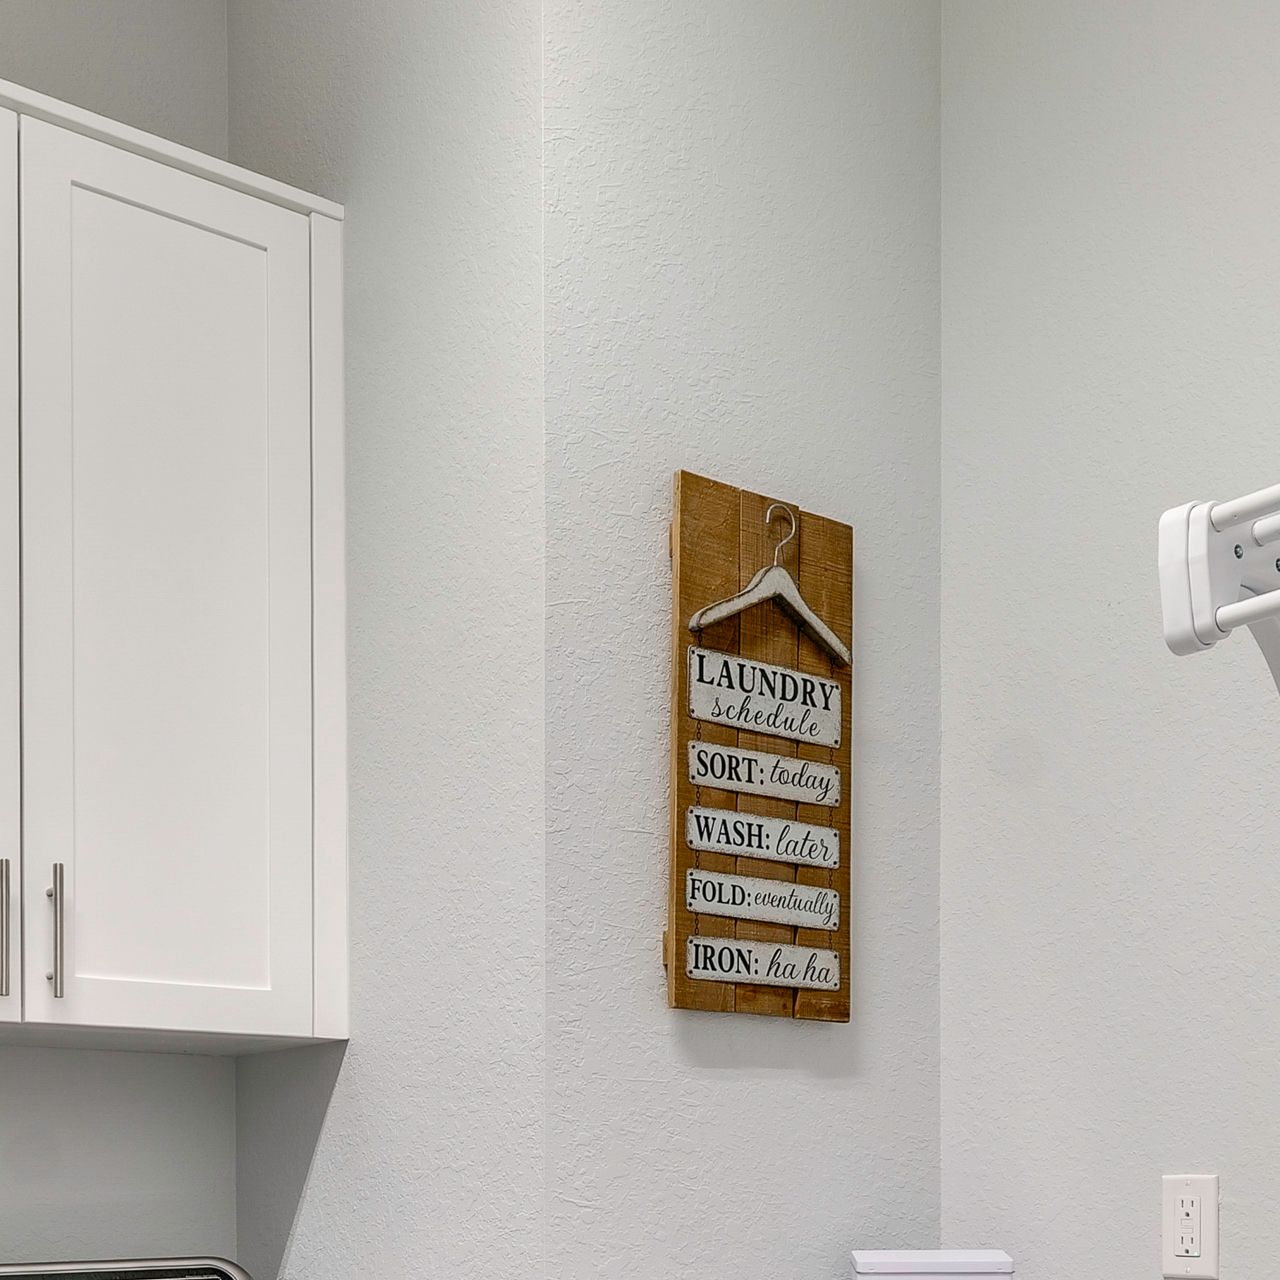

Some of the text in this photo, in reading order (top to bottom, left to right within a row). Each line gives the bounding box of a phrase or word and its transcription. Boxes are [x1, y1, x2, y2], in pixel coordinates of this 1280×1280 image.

[696, 653, 835, 711] LAUNDRY
[711, 695, 821, 737] schedule
[696, 749, 835, 802] SORT: today
[694, 814, 833, 862] WASH: later
[690, 878, 837, 925] FOLD: eventually
[693, 943, 834, 984] IRON: ha ha
